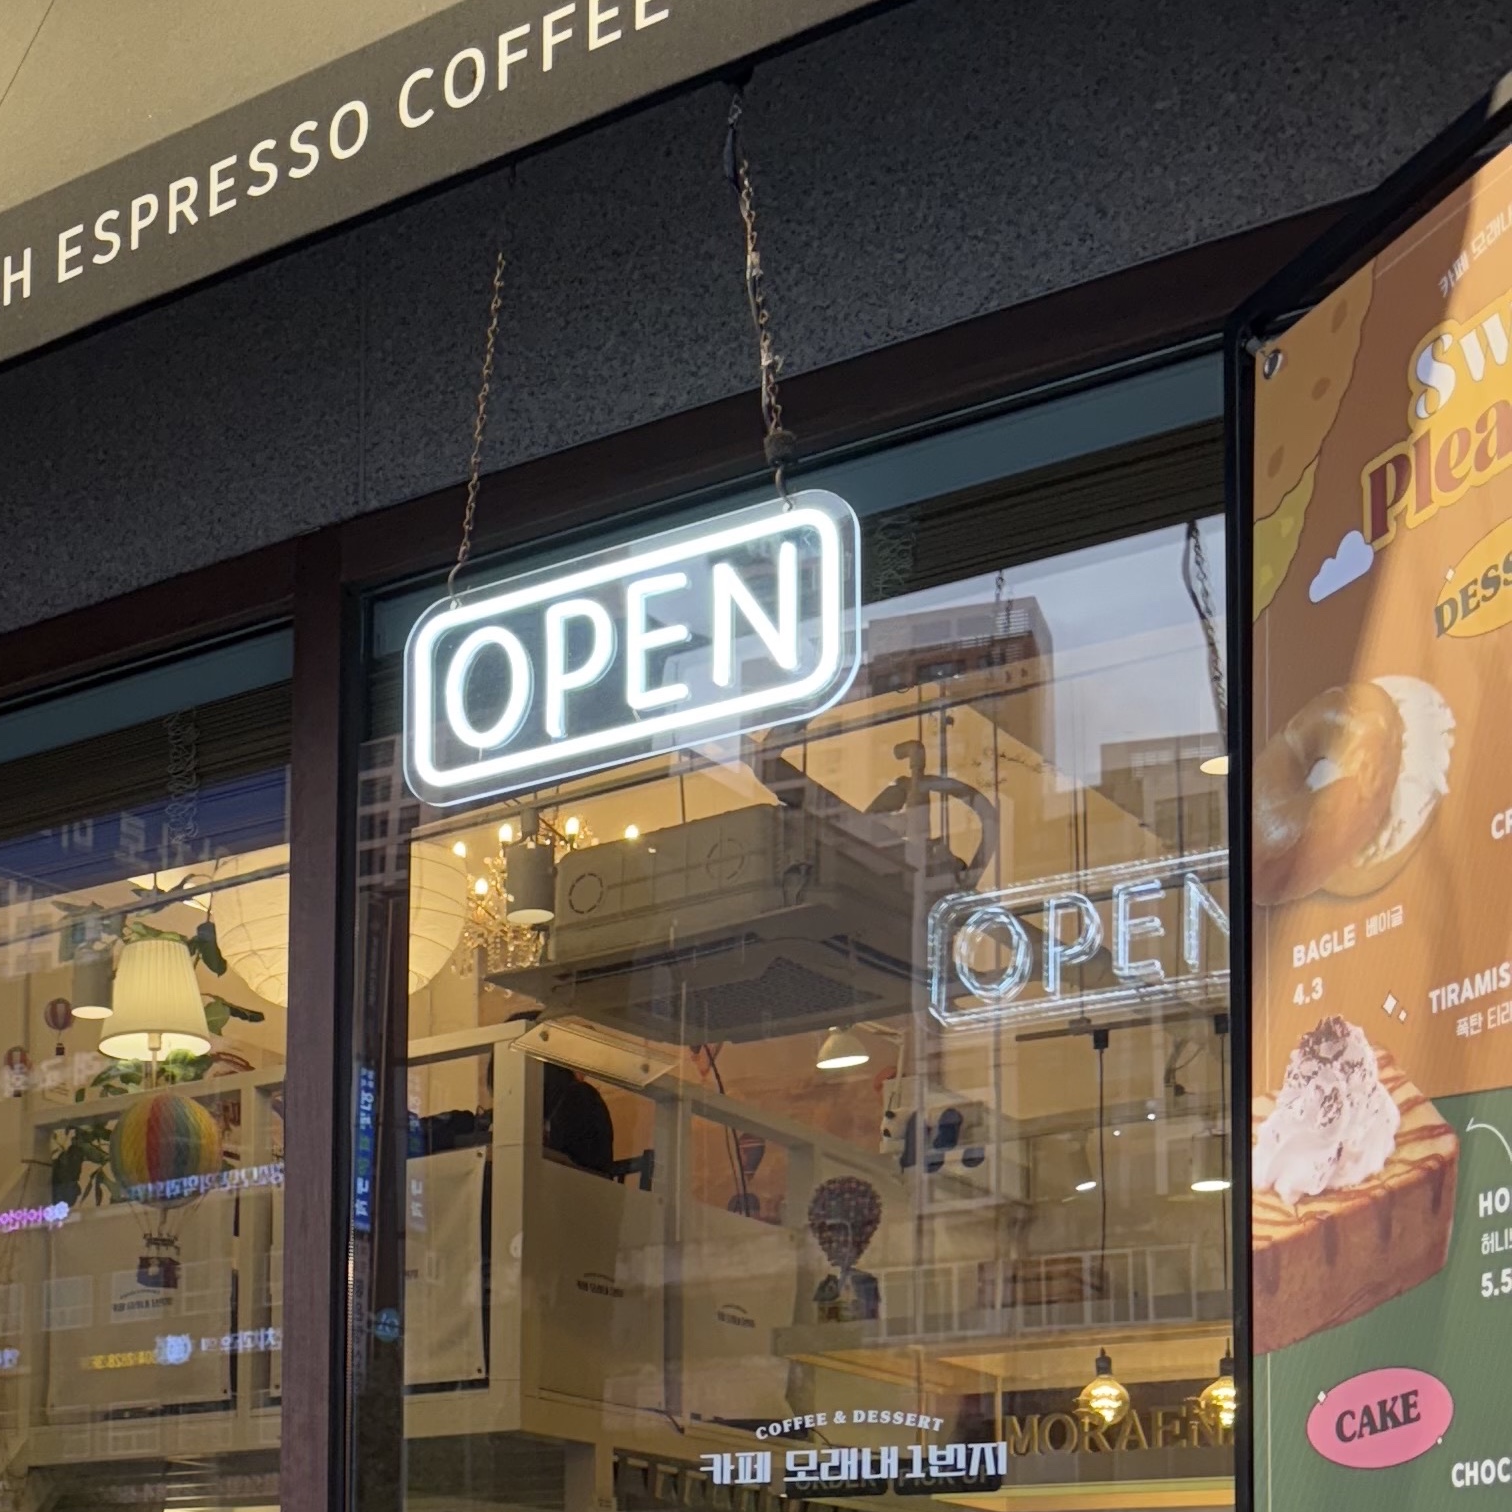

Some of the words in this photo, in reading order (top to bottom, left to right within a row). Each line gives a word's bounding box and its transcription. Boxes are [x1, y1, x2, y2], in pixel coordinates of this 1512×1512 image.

[56, 100, 368, 283] ESPRESSO
[445, 540, 799, 750] OPEN
[1292, 924, 1356, 969] BAGLE
[1365, 905, 1404, 938] 베이글
[1293, 976, 1324, 1006] 4.3
[1428, 961, 1512, 1014] TIRAMIS
[1455, 1012, 1484, 1037] 폭탄
[1481, 1267, 1512, 1298] 5.5
[755, 1411, 829, 1440] COFFEE
[834, 1409, 847, 1424] &
[852, 1409, 945, 1432] DESSERT
[1005, 1405, 1235, 1456] MORAEN
[1335, 1389, 1422, 1443] CAKE
[699, 1450, 771, 1485] 카페
